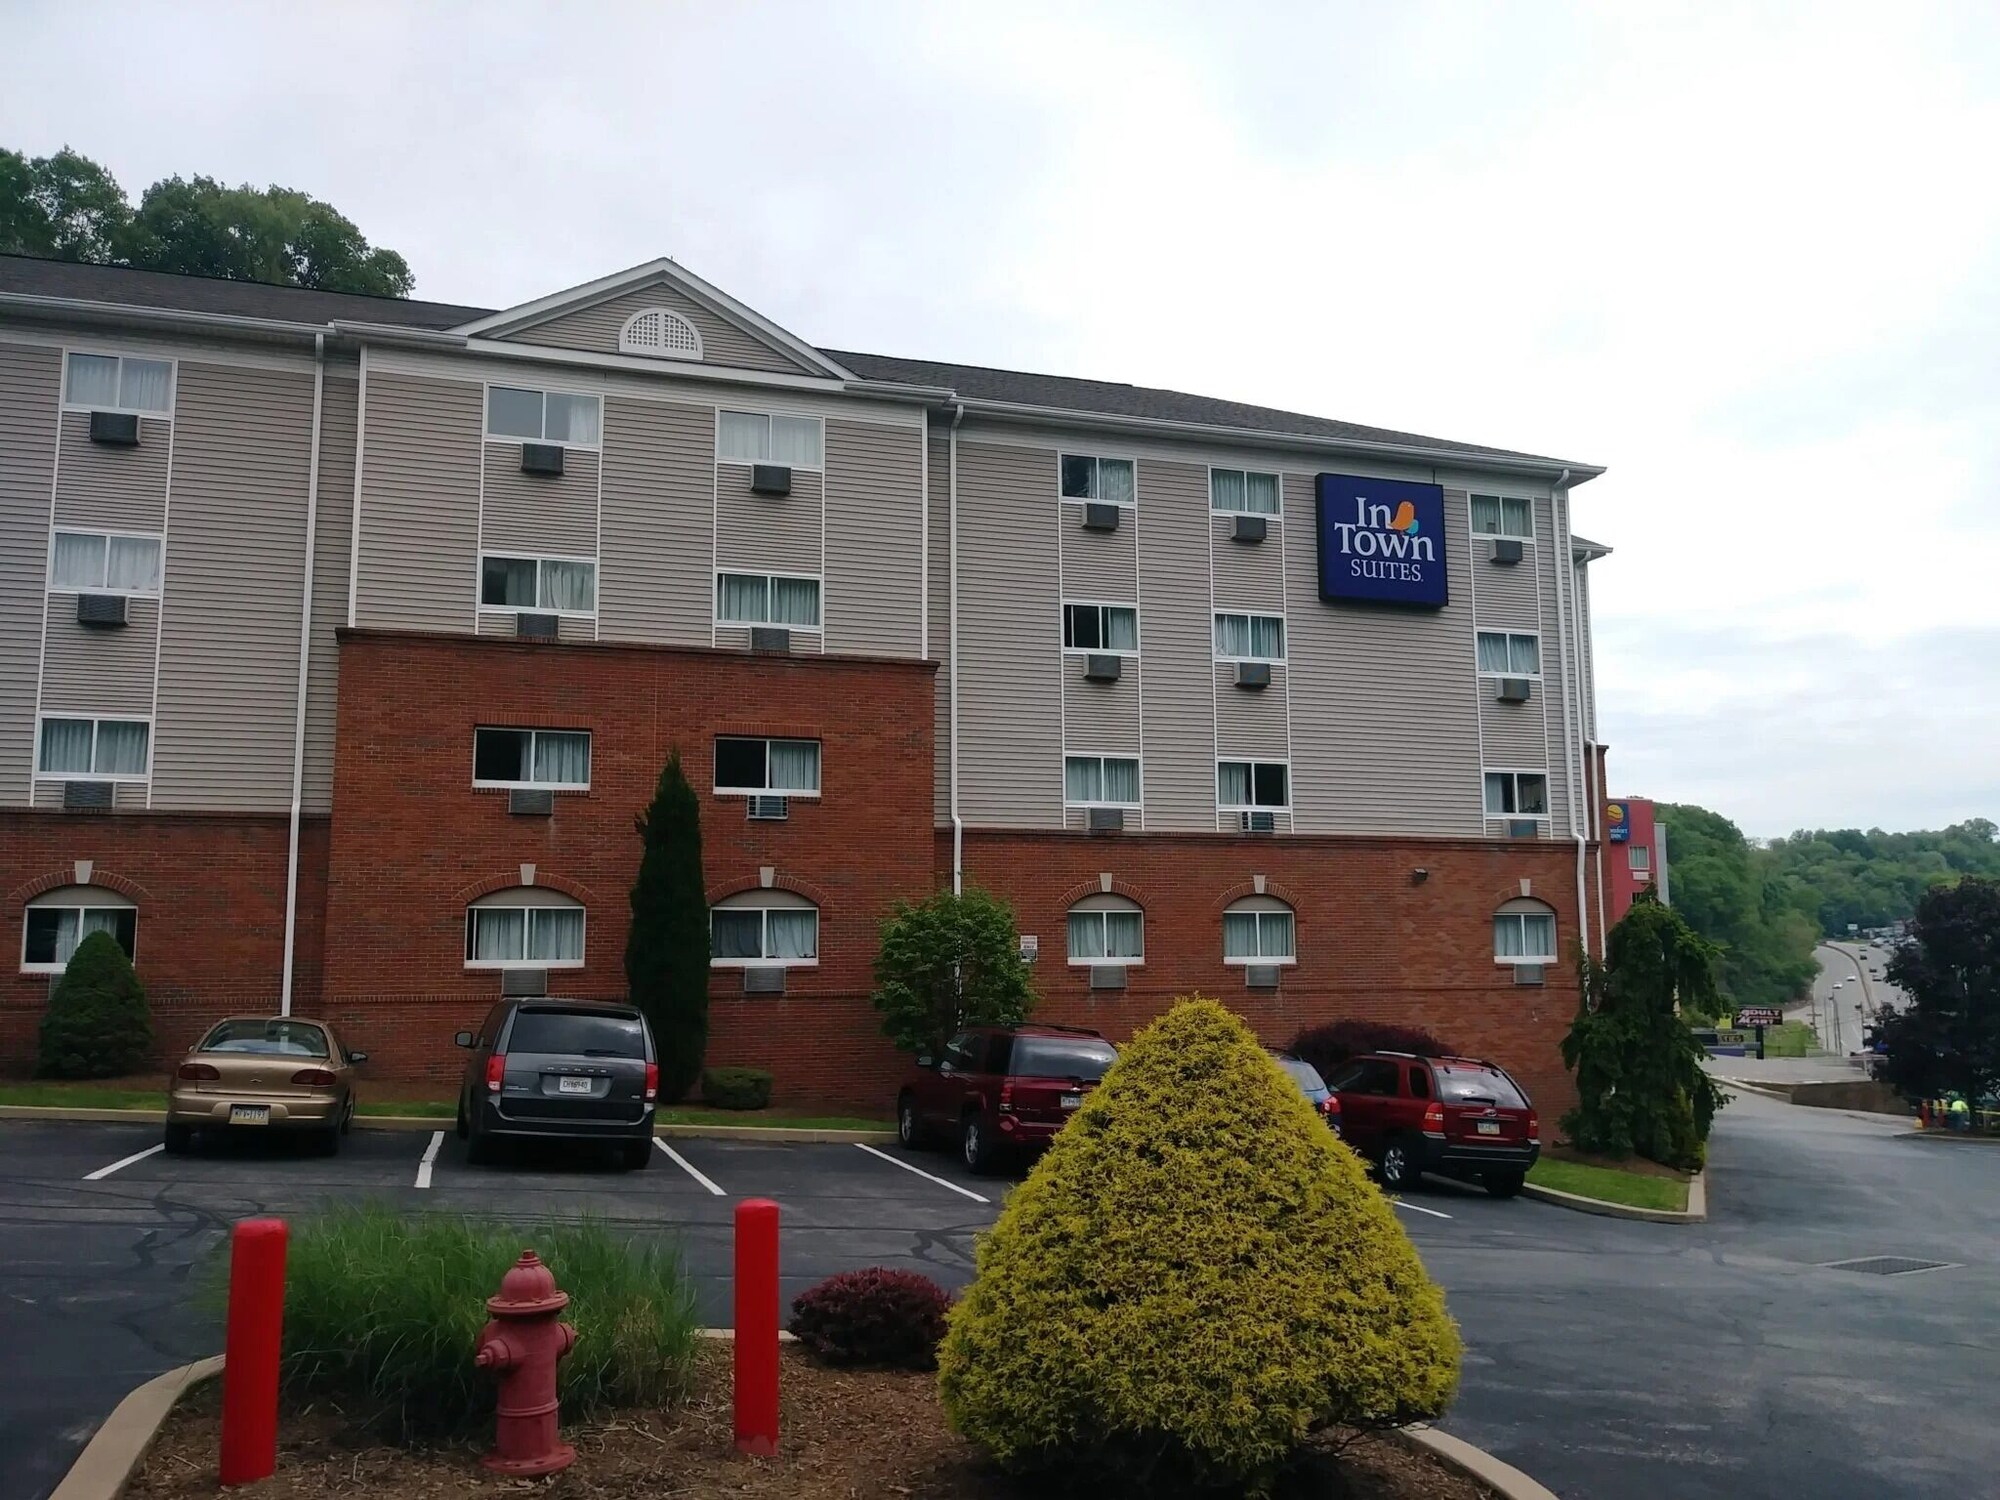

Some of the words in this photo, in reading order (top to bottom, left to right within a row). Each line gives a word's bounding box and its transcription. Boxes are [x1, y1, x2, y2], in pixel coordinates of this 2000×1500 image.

[1355, 497, 1393, 529] In
[1334, 522, 1436, 561] Town
[1351, 558, 1422, 582] SUITES
